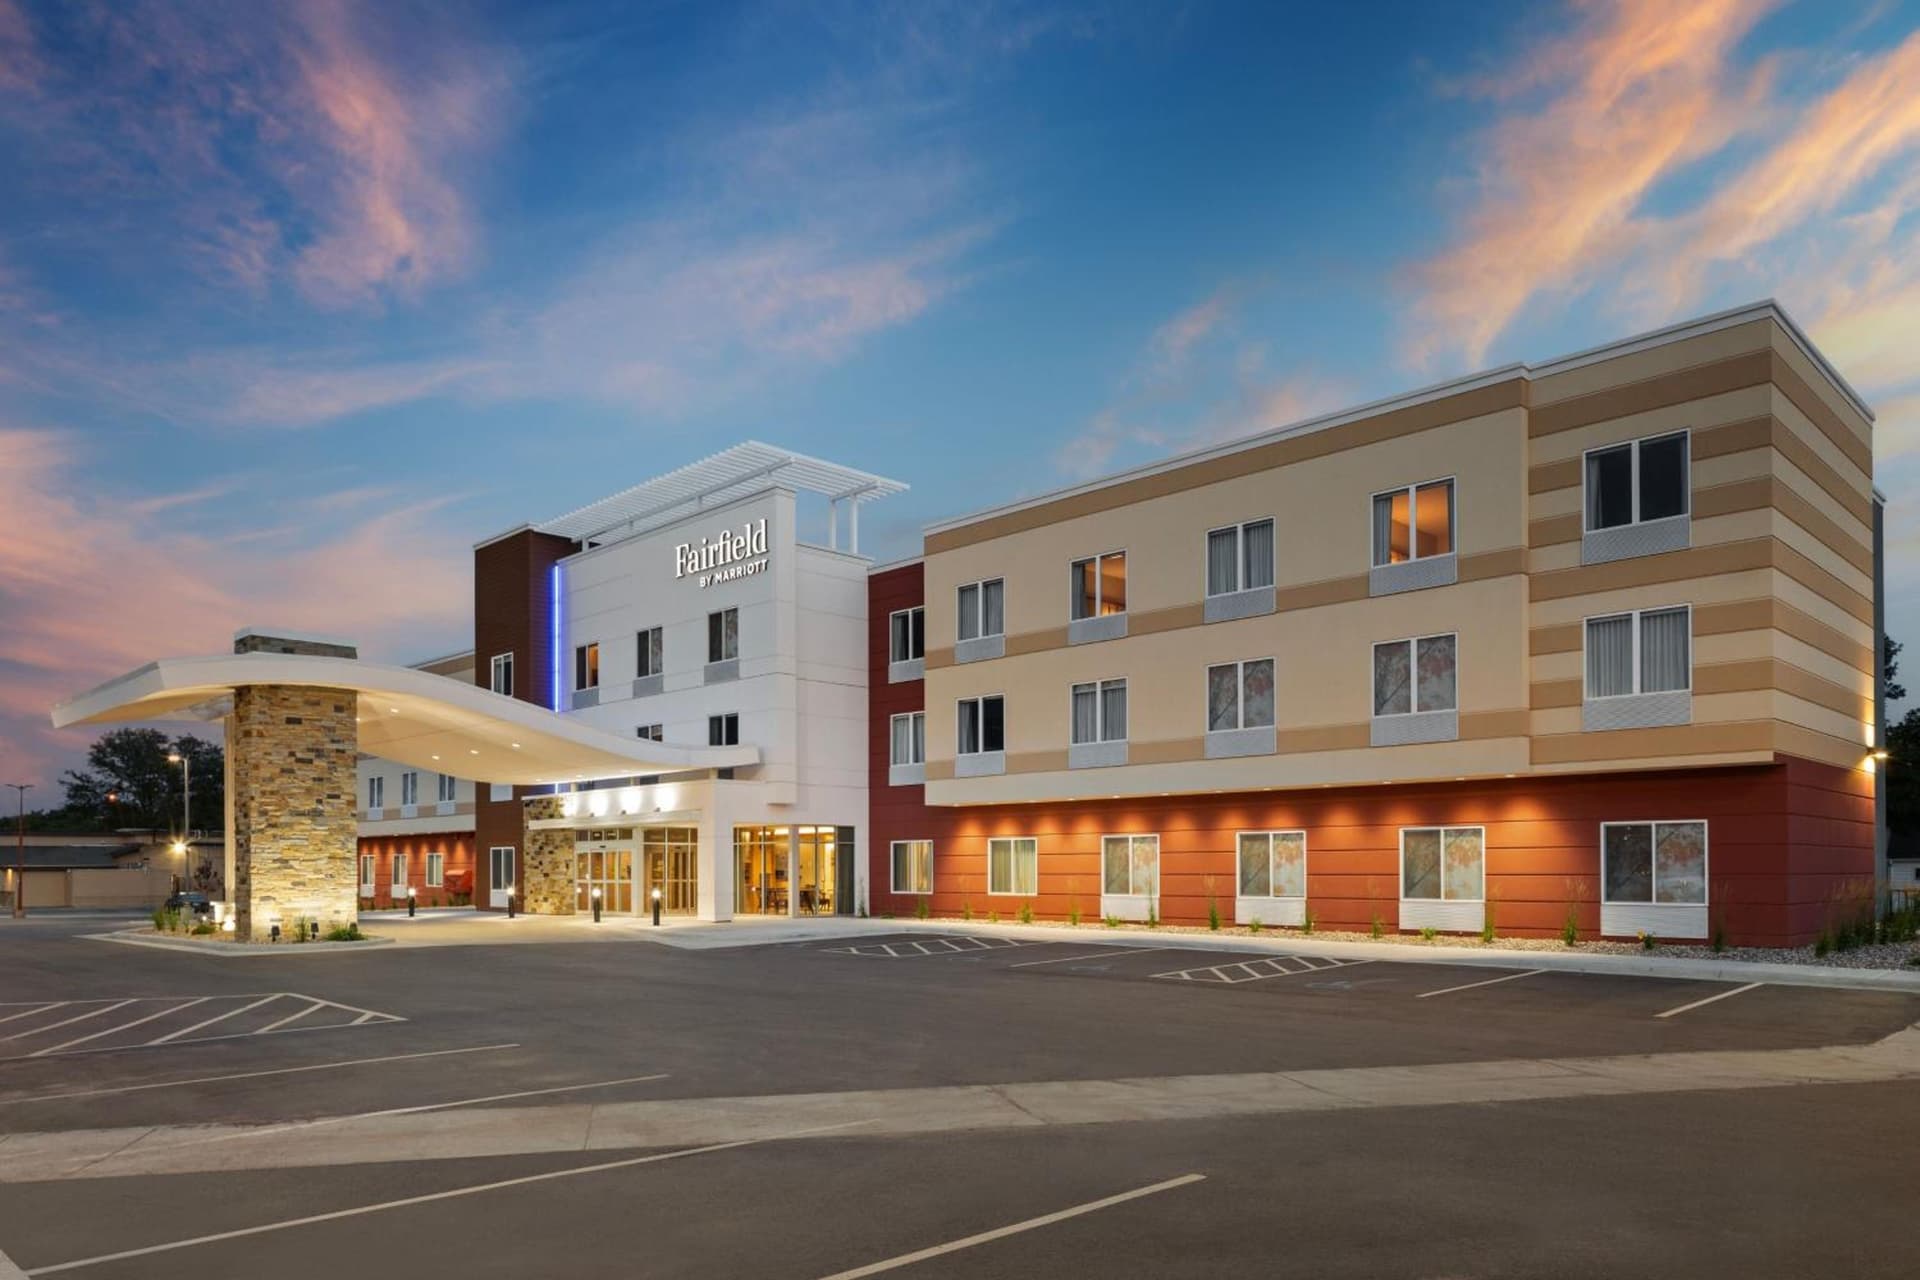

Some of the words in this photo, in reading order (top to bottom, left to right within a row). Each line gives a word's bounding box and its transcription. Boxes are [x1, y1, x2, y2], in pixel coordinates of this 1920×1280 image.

[675, 518, 768, 578] Fairfield
[699, 575, 713, 588] BY
[715, 559, 768, 584] MARRIOTT
